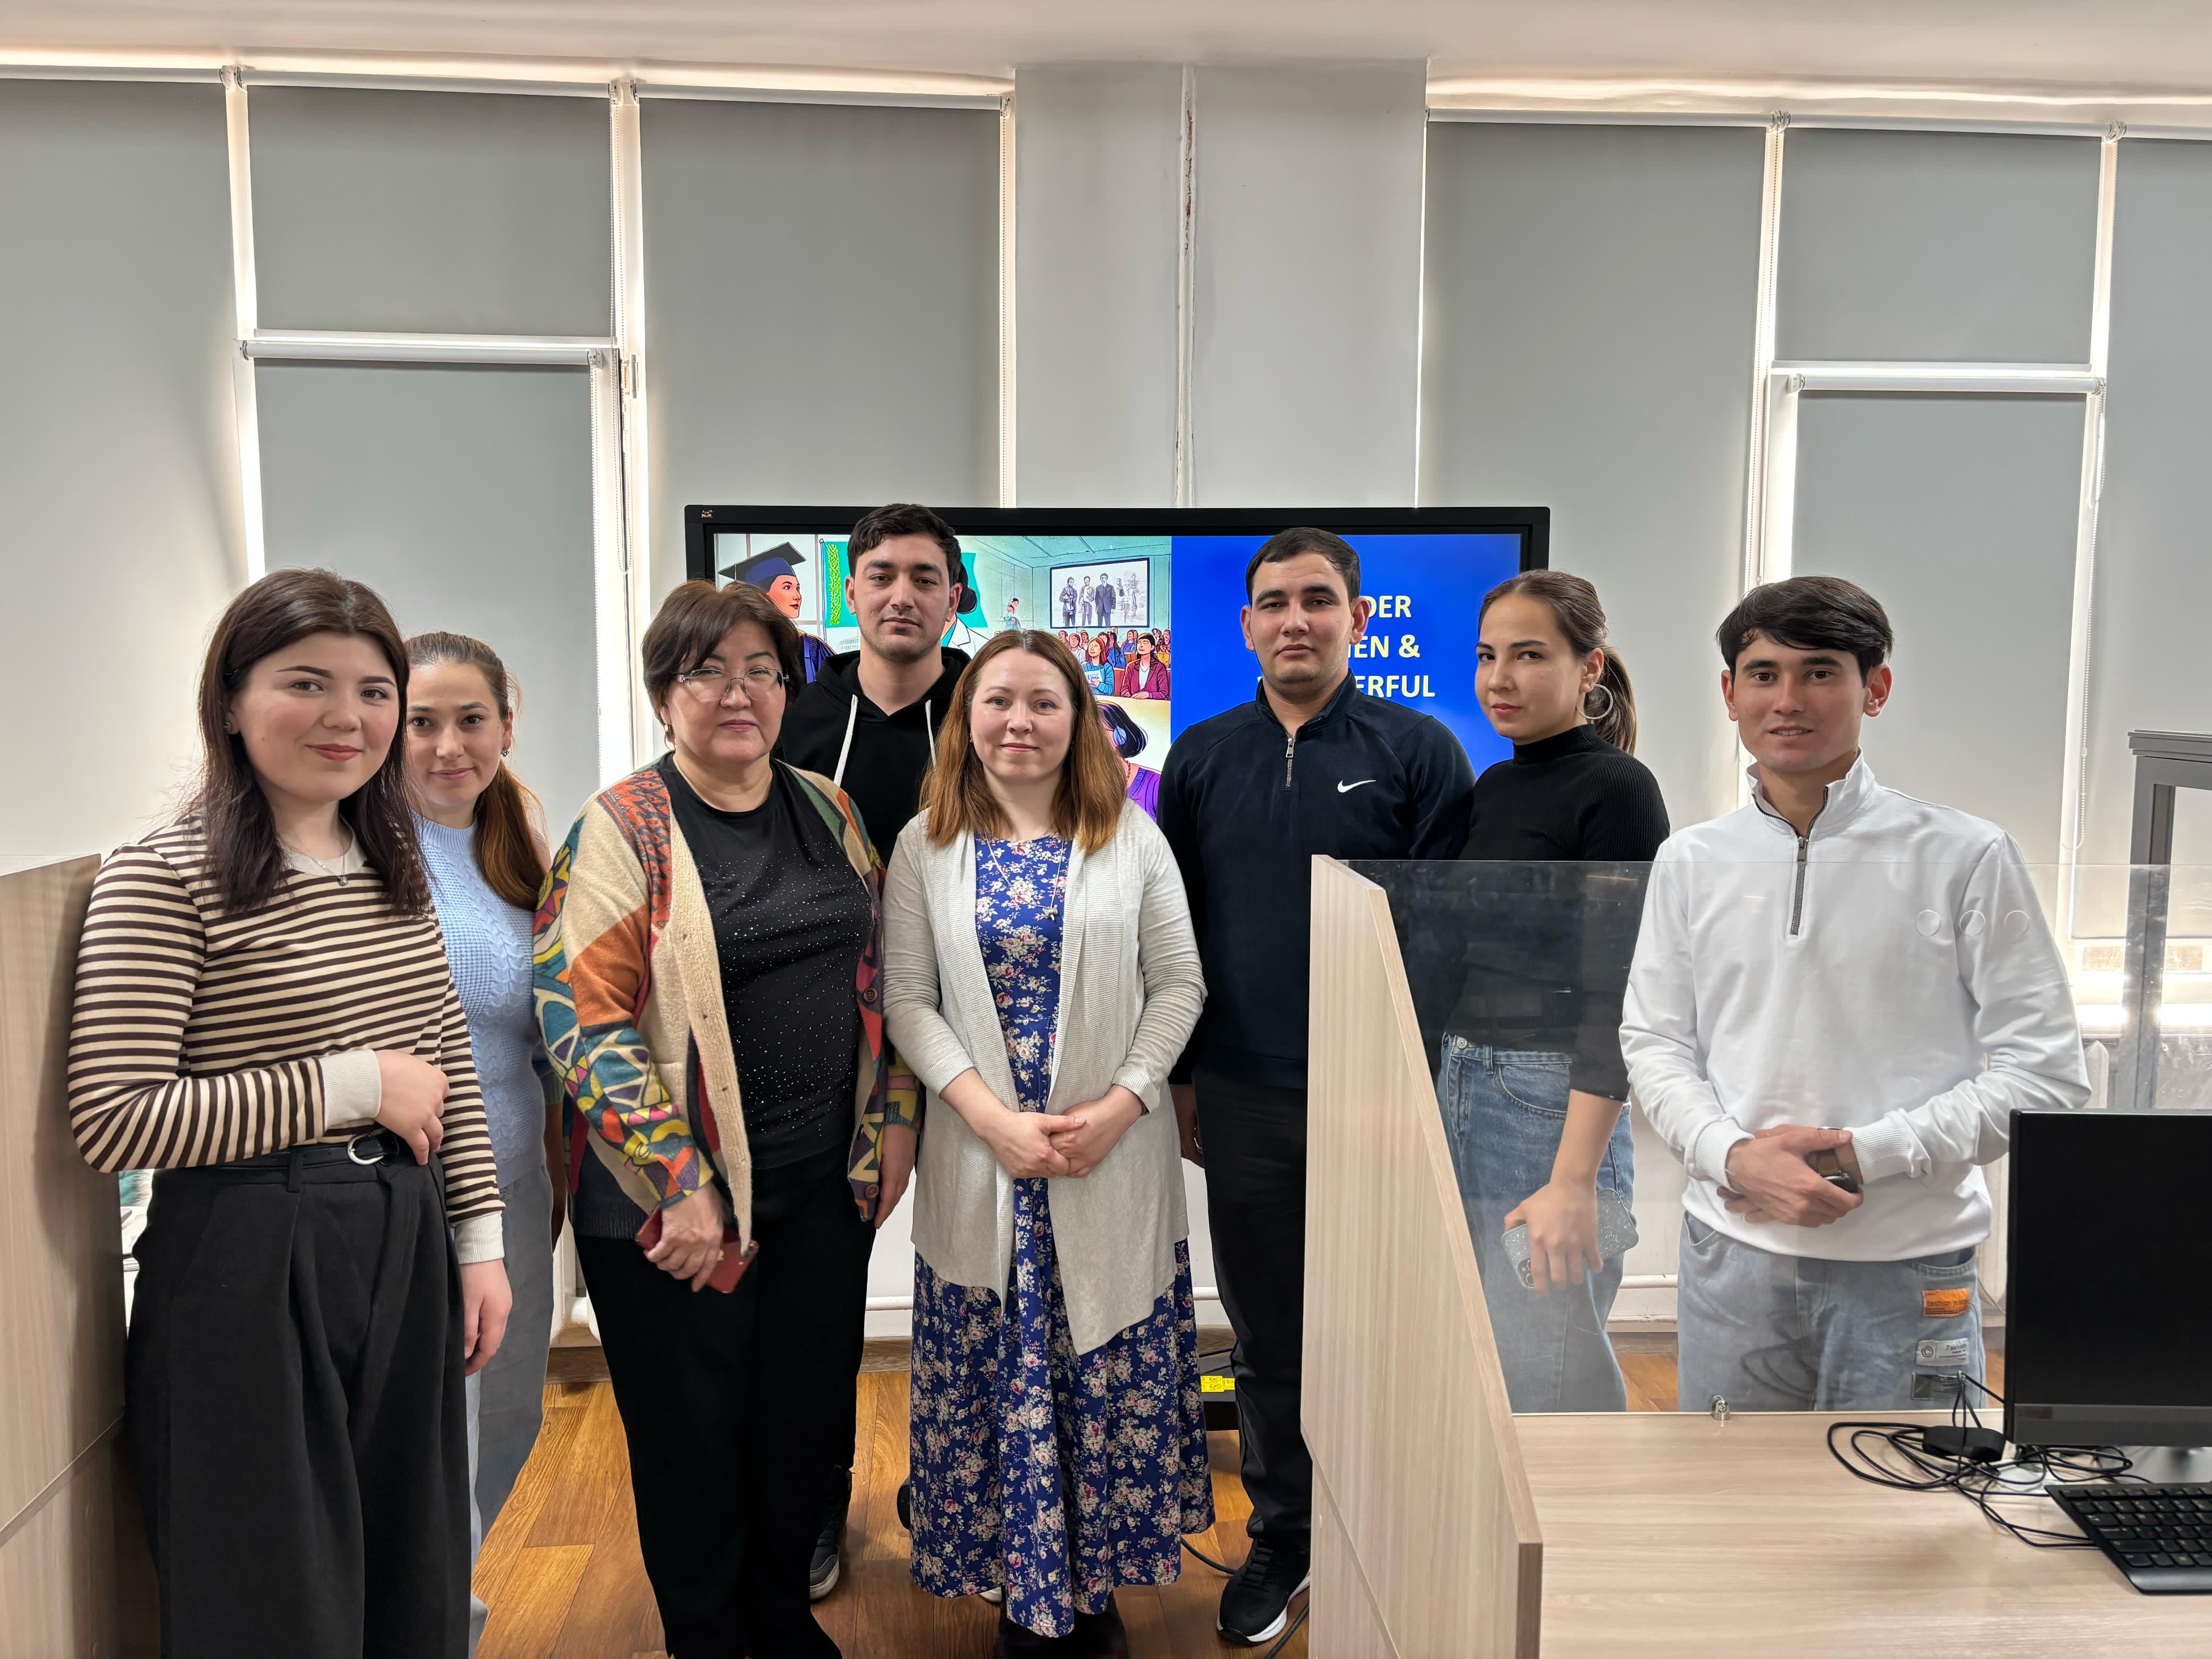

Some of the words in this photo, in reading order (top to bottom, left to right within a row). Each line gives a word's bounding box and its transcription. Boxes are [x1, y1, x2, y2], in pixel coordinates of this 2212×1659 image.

[1359, 595, 1412, 618] DER
[1347, 635, 1389, 658] EN
[1398, 634, 1420, 658] &
[1354, 675, 1436, 698] ERFUL
